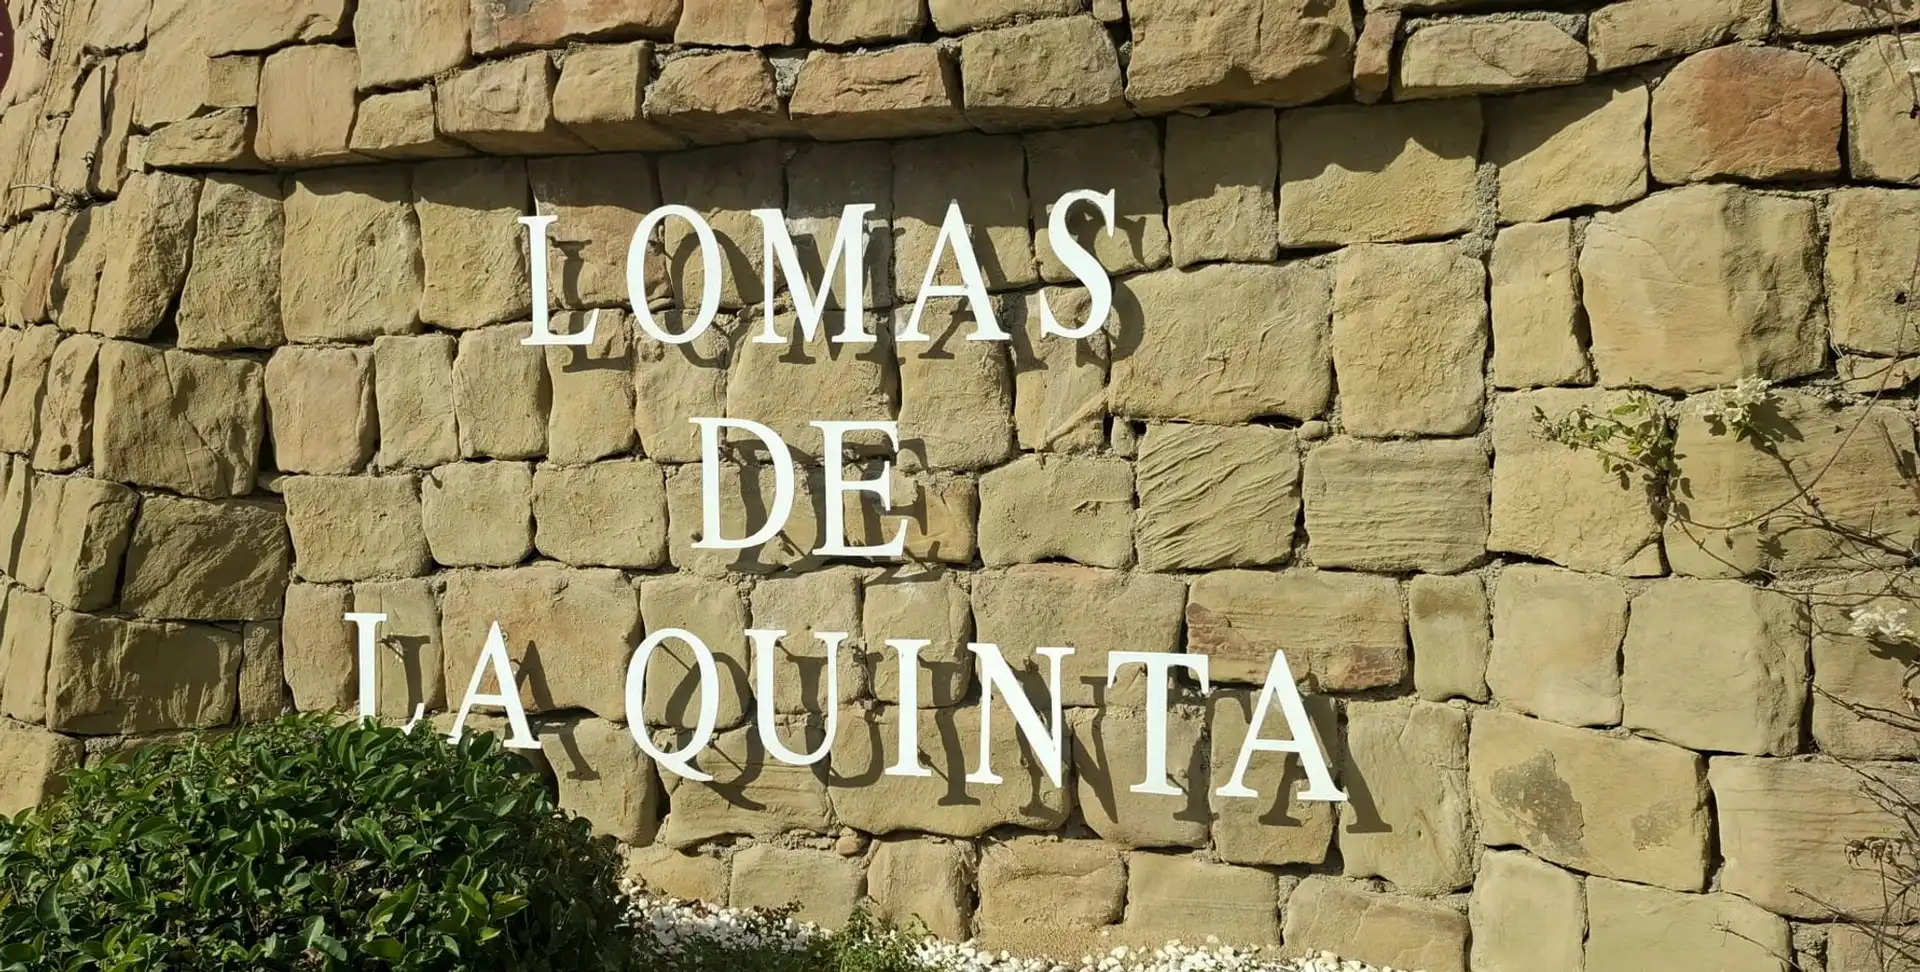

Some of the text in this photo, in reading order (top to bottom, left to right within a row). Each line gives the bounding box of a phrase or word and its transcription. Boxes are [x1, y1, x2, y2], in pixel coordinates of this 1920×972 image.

[519, 189, 1116, 347] LOMAS
[689, 417, 908, 557] DE
[344, 612, 1348, 803] LA QUINTA
